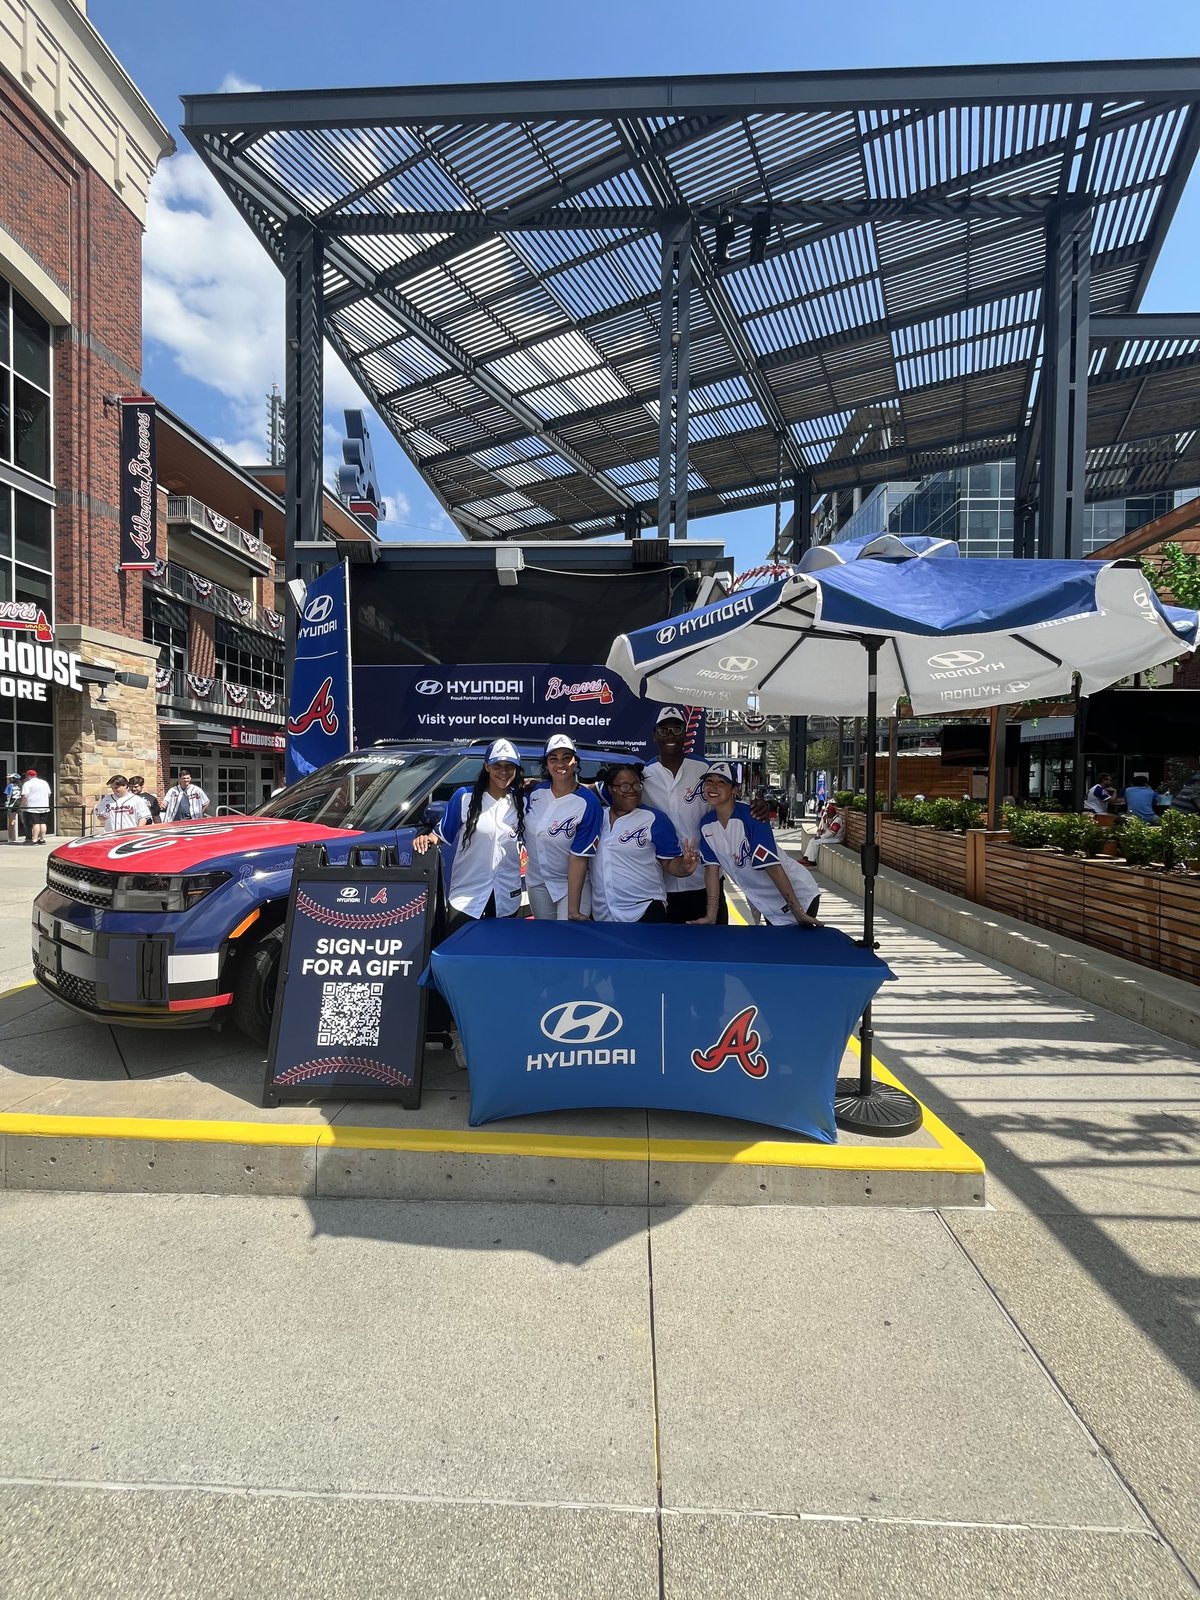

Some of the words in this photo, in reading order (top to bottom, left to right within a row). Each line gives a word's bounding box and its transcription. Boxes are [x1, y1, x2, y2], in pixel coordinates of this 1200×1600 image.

[128, 412, 153, 482] Braves
[130, 482, 152, 560] Atlanta
[680, 596, 754, 635] HYUNDAI
[298, 620, 338, 639] HYUNDAI
[446, 680, 523, 693] HYUNDAI
[545, 677, 602, 700] Braves
[418, 713, 446, 725] Visit
[448, 715, 476, 726] your
[479, 713, 509, 725] local
[512, 714, 566, 726] Hyundai
[569, 715, 612, 726] Dealer
[241, 731, 275, 747] CLUBHOUSE
[316, 938, 403, 956] SIGN-UP
[302, 959, 343, 976] FOR
[347, 960, 362, 976] A
[366, 960, 413, 976] GIFT
[691, 1005, 769, 1080] A
[527, 1049, 636, 1072] HYUNDAI
